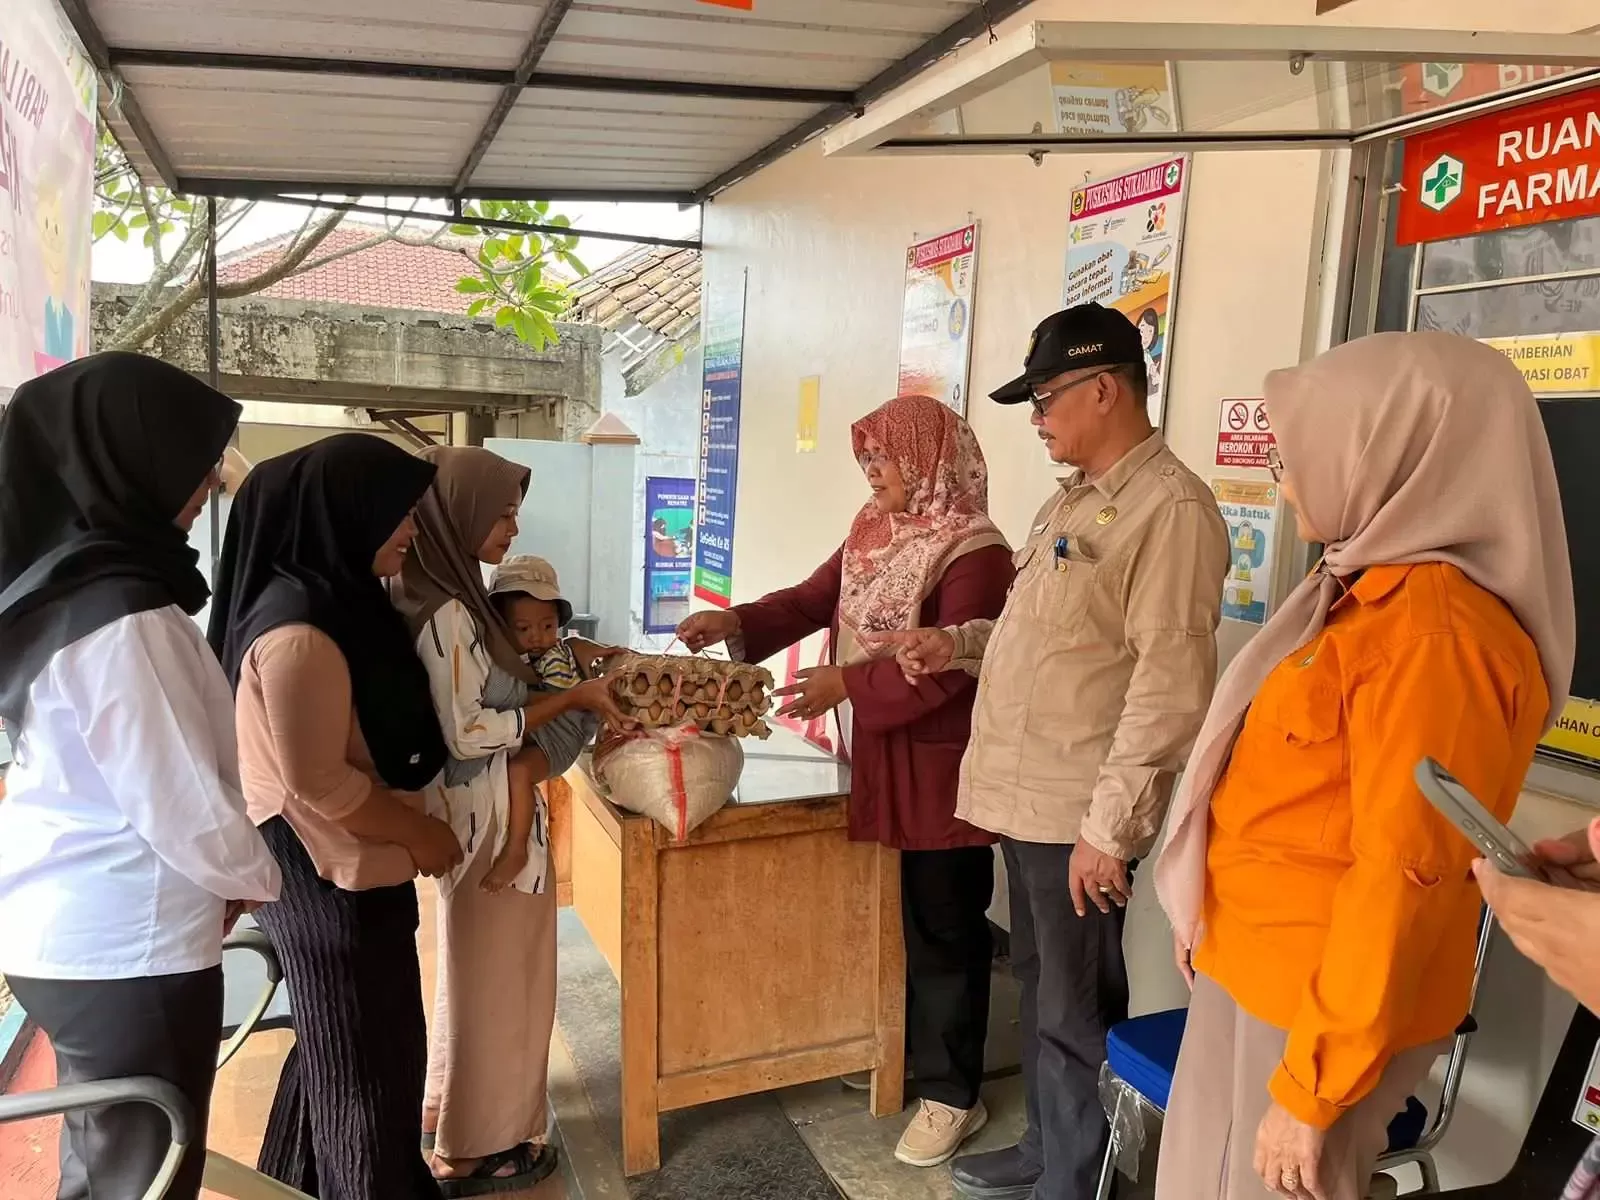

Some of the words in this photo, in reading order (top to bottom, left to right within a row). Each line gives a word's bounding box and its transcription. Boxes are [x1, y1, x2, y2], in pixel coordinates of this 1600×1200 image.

[1068, 260, 1096, 281] Gunakan
[1097, 249, 1113, 264] obat
[1067, 275, 1088, 294] secara
[1088, 264, 1107, 283] tepat
[1066, 291, 1081, 306] baca
[1081, 272, 1113, 297] informasi
[1067, 343, 1104, 357] CAMAT
[1553, 366, 1590, 380] OBAT
[1219, 442, 1253, 454] MEROKOK
[1240, 507, 1271, 520] Batuk
